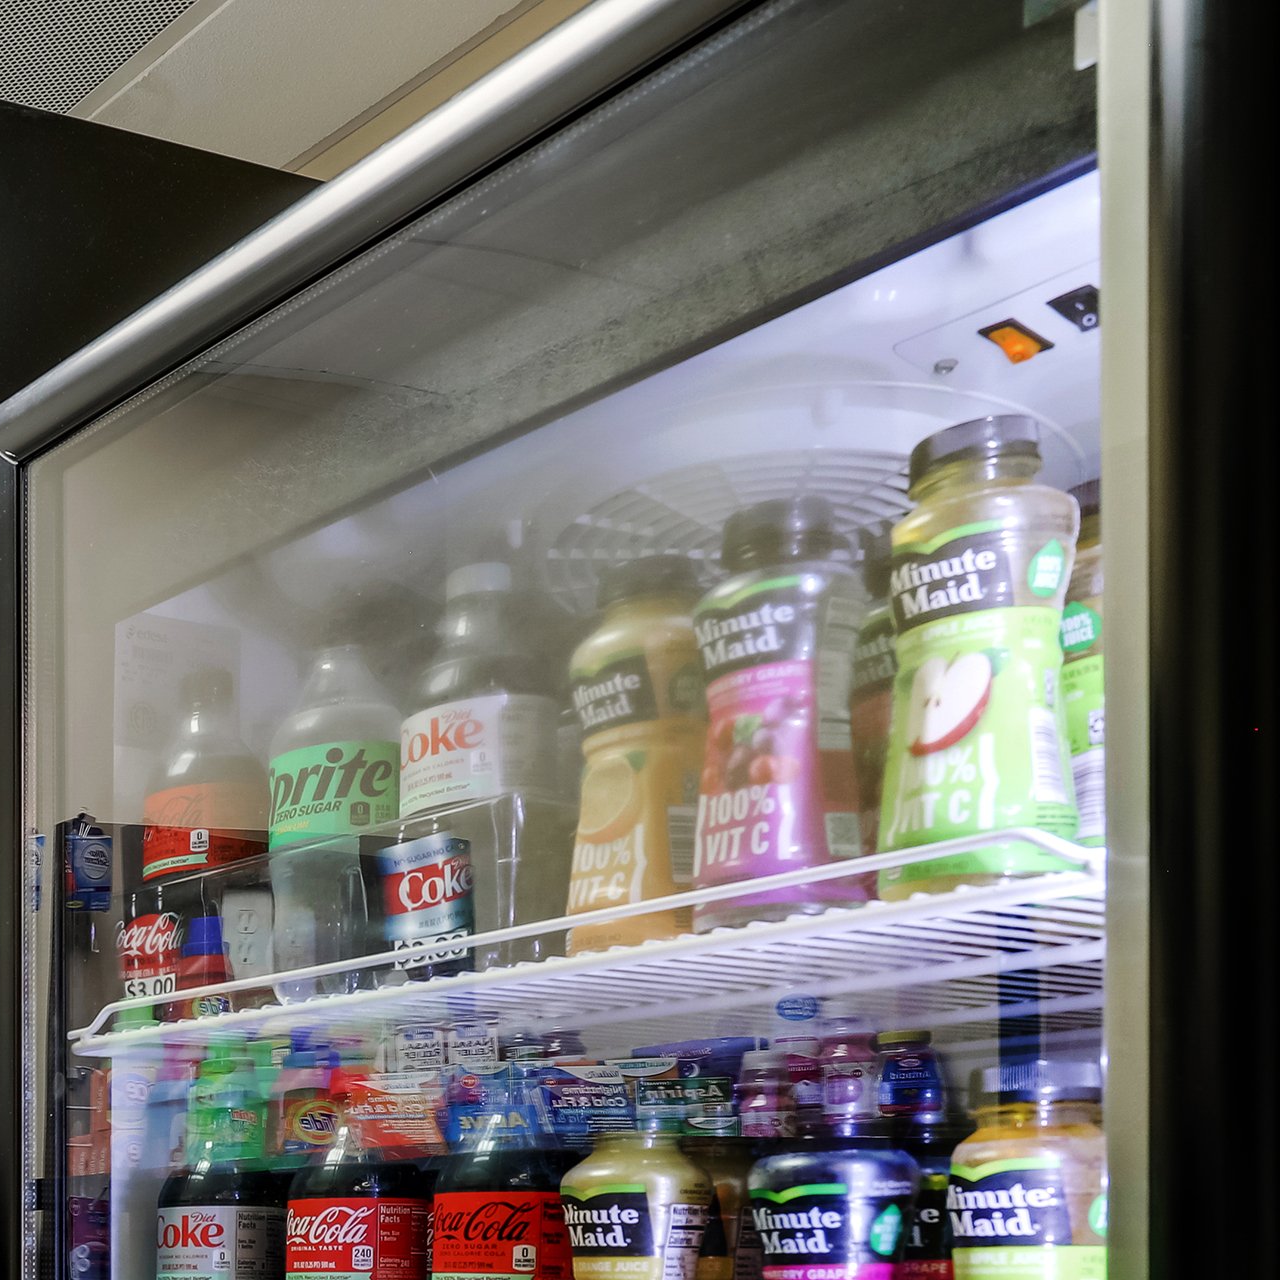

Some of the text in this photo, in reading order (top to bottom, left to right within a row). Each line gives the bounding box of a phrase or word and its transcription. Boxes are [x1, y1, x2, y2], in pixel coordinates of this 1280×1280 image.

[891, 548, 998, 597] Minute
[900, 574, 987, 621] Maid
[694, 602, 796, 656] Minute
[1061, 626, 1096, 648] JUICE
[701, 628, 785, 672] Maid
[574, 668, 641, 712] Minute
[441, 709, 473, 725] Diet
[579, 698, 632, 732] Maid
[400, 717, 485, 772] Coke
[275, 800, 344, 823] ZERO SUGAR
[707, 783, 775, 830] 100%
[195, 830, 203, 841] 0
[706, 819, 770, 868] VIT C
[398, 862, 474, 913] Coke
[115, 911, 185, 959] Coca-Cola
[126, 976, 175, 998] $3.00
[190, 1211, 218, 1225] Diet
[380, 1205, 411, 1216] Nutrition
[380, 1214, 401, 1225] Facts
[561, 1202, 640, 1227] Minute
[752, 1206, 843, 1230] Minute
[157, 1214, 225, 1250] Coke
[290, 1244, 344, 1252] ORIGINAL TASTE
[353, 1247, 372, 1259] 240
